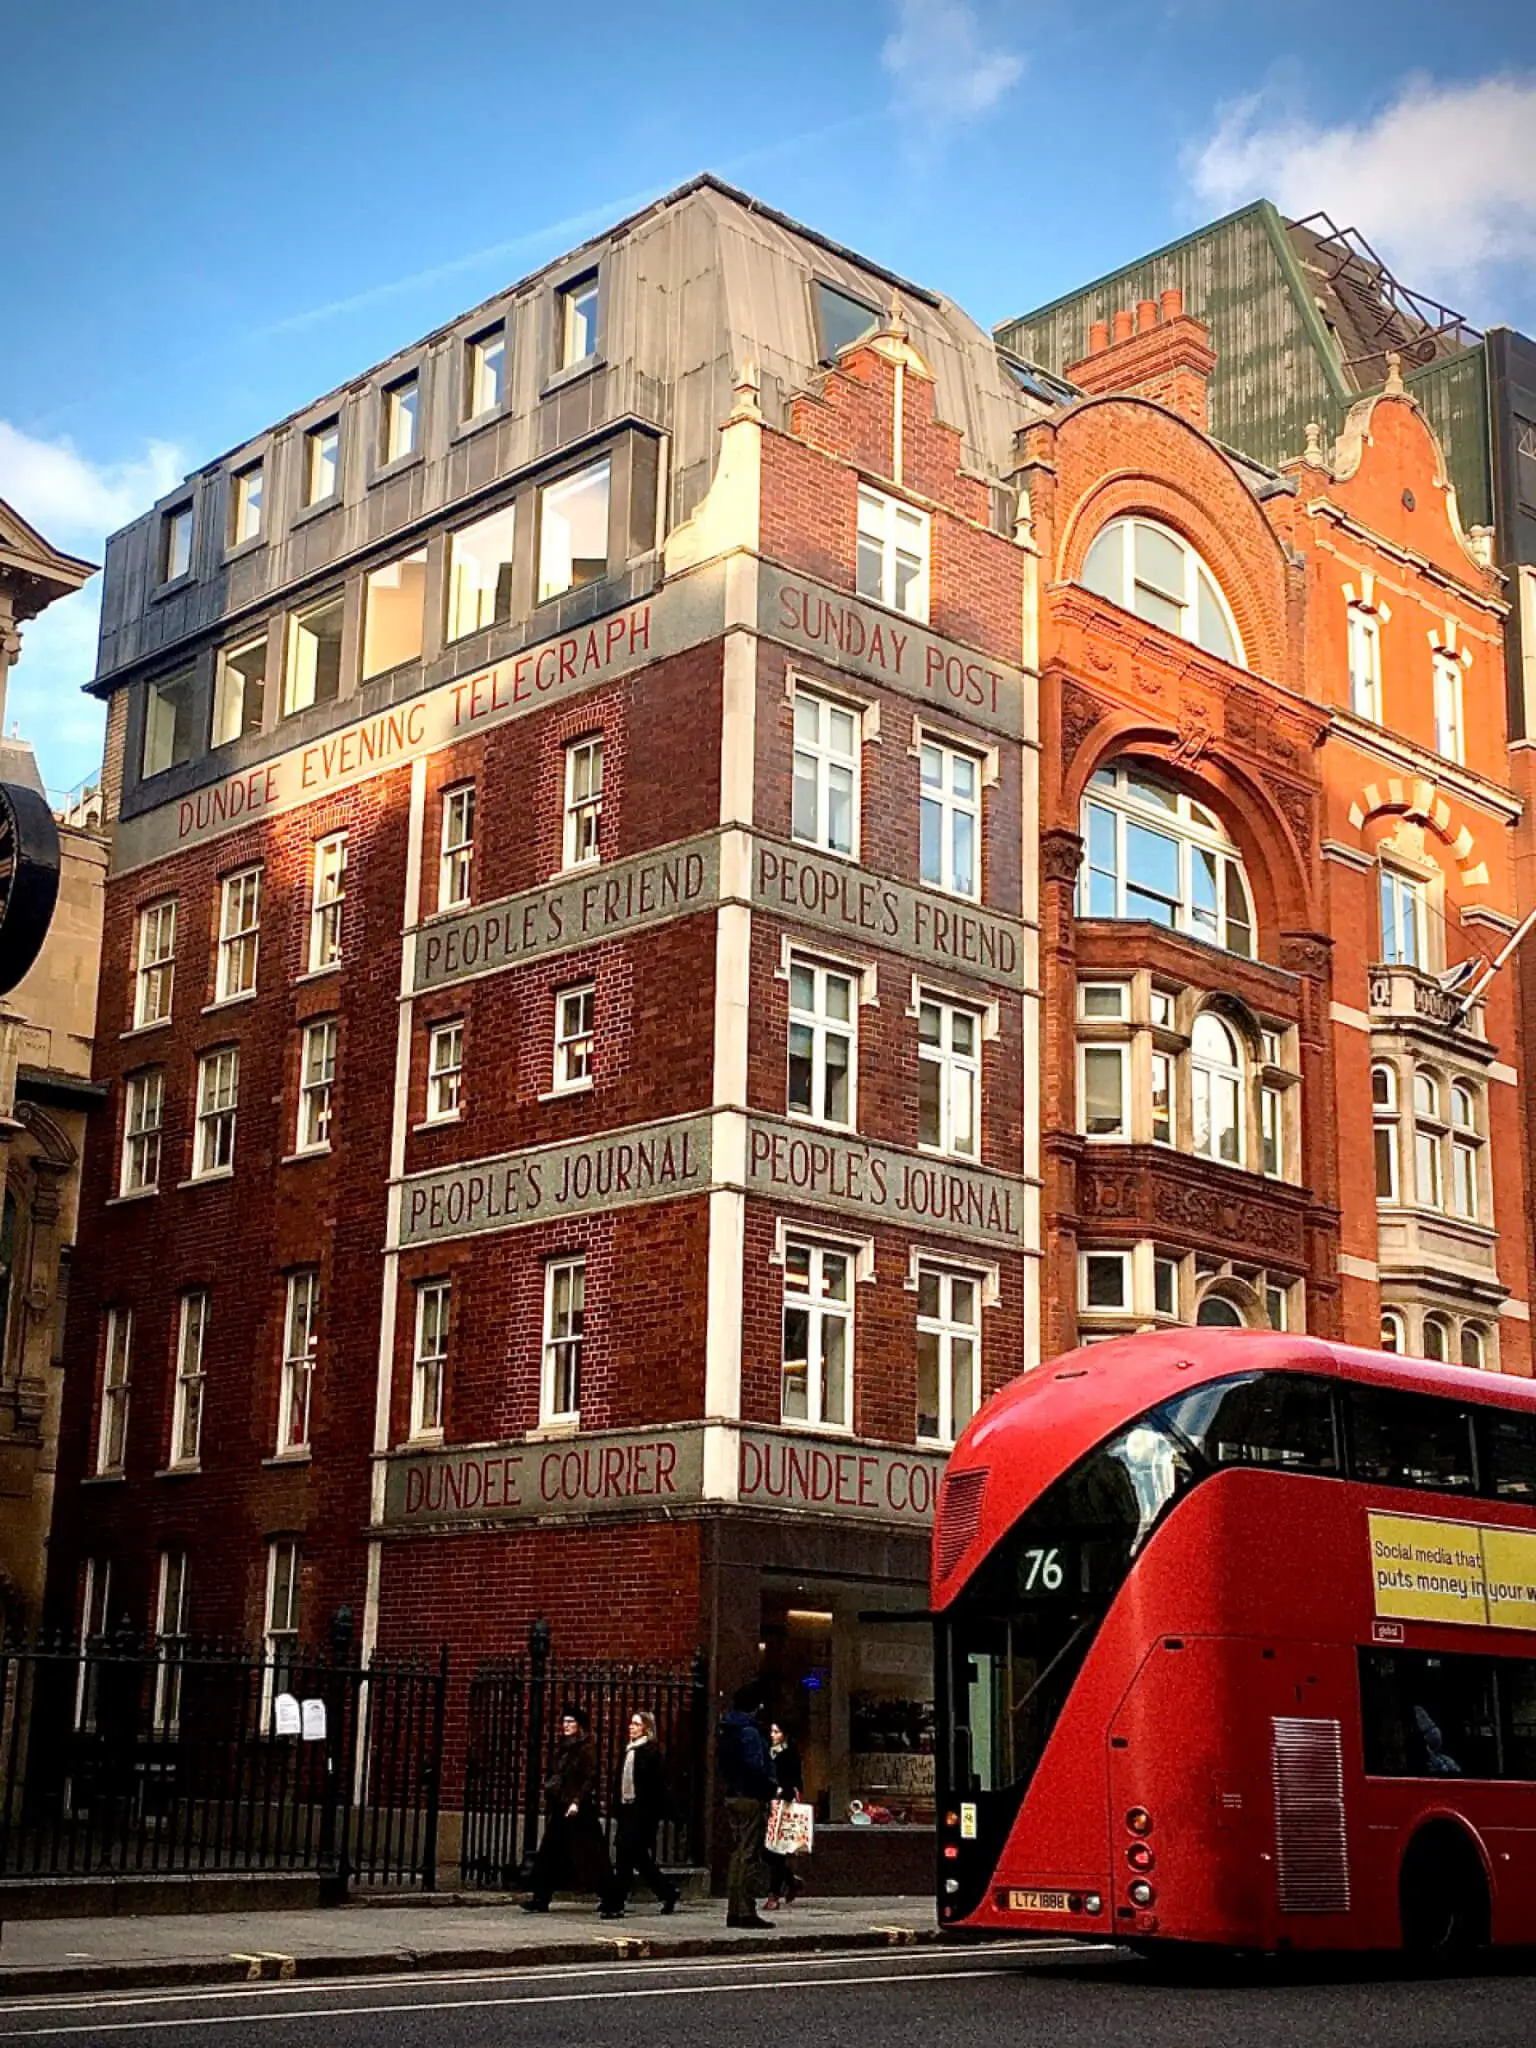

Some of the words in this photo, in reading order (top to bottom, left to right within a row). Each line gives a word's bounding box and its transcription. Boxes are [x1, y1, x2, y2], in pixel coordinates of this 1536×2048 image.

[778, 586, 909, 674] SUNDAY
[925, 646, 1004, 713] POST
[178, 763, 281, 838] DUNDEE
[302, 704, 426, 788] EVENING
[450, 606, 652, 727] TELEGRAPH
[425, 896, 562, 979] PEOPLE'S
[582, 853, 705, 928] FRIEND
[758, 848, 899, 936] PEOPLE'S
[914, 902, 1017, 974] FRIEND
[410, 1159, 541, 1233] PEOPLE'S
[555, 1130, 698, 1202] JOURNAL
[750, 1129, 888, 1205] PEOPLE'S
[896, 1169, 1020, 1236] JOURNAL
[406, 1457, 523, 1513] DUNDEE
[540, 1441, 678, 1501] COURIER
[738, 1441, 880, 1509] DUNDEE
[1024, 1548, 1063, 1590] 76
[1375, 1540, 1412, 1561] Social
[1416, 1547, 1453, 1566] media
[1456, 1549, 1483, 1569] that
[1378, 1568, 1413, 1592] puts
[1417, 1574, 1467, 1599] money
[1471, 1575, 1486, 1596] in
[1489, 1583, 1522, 1603] your
[1015, 1892, 1037, 1908] LTZ
